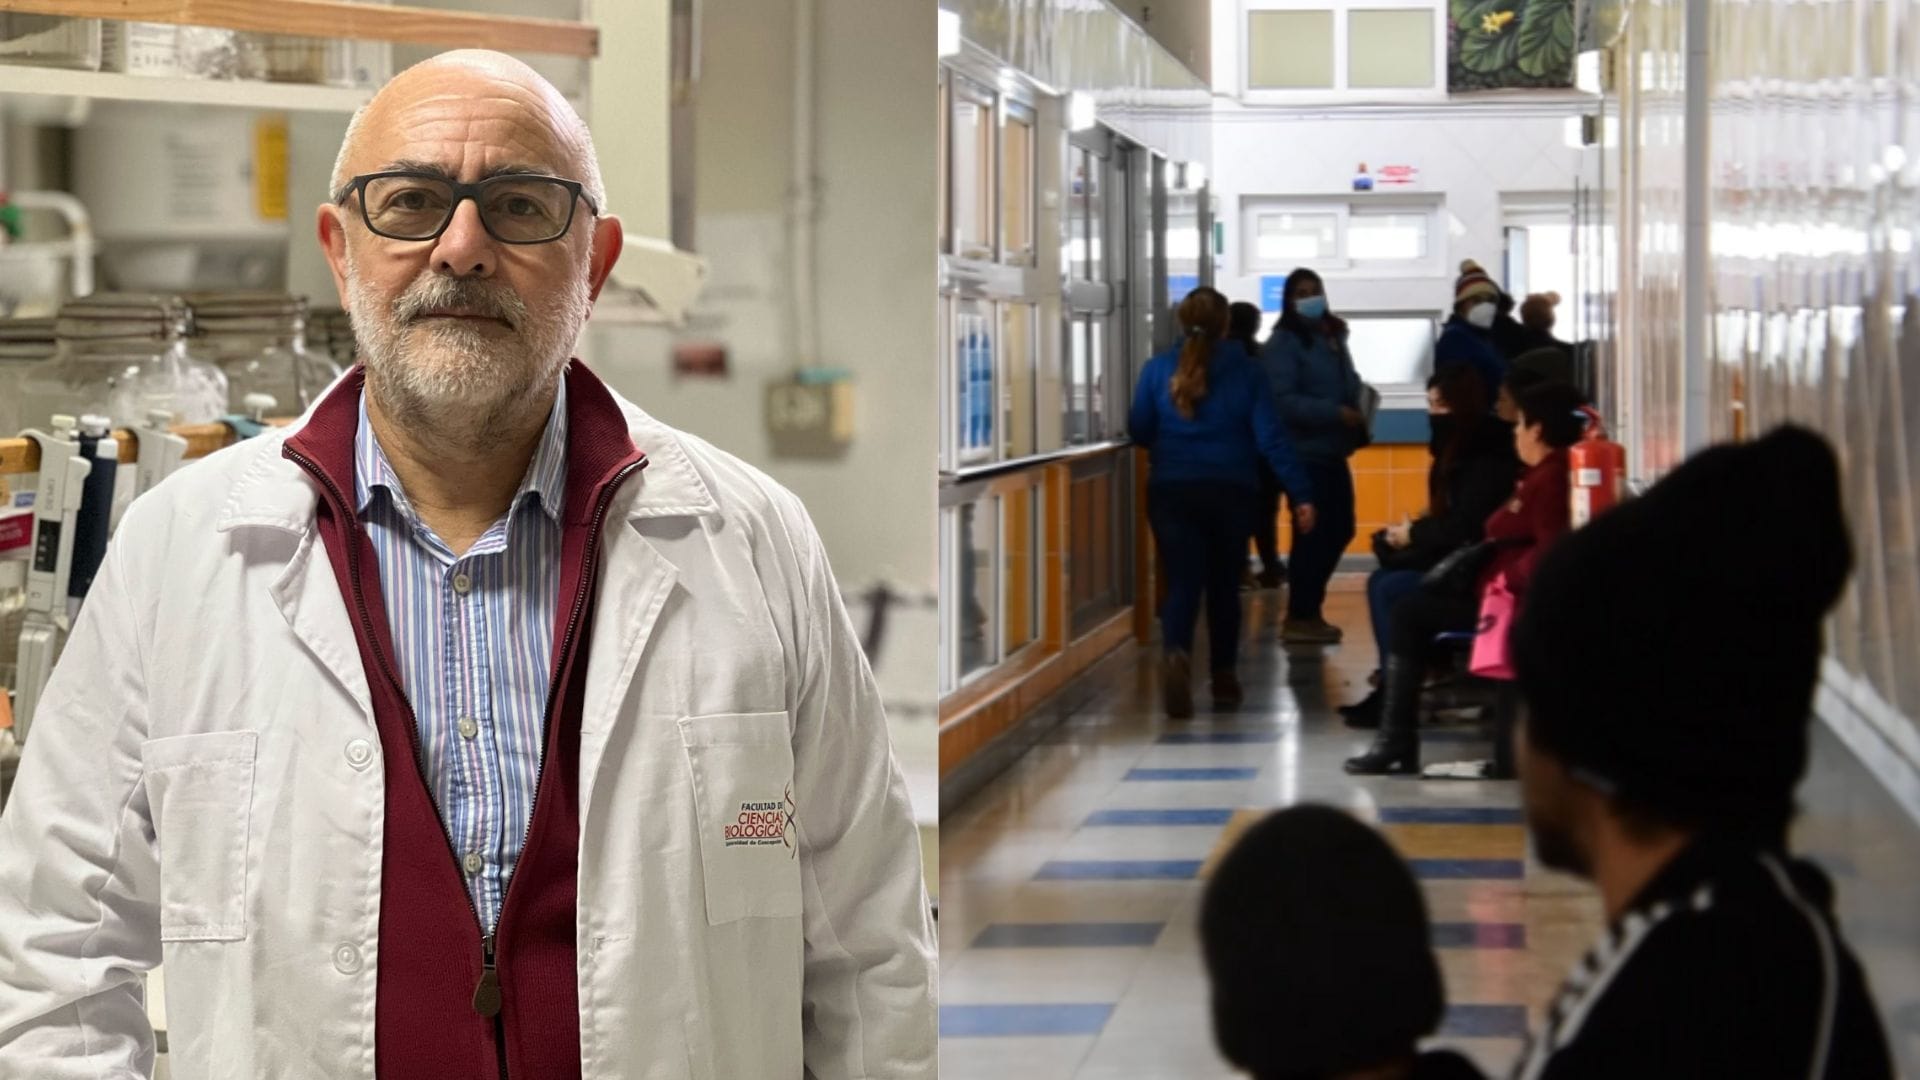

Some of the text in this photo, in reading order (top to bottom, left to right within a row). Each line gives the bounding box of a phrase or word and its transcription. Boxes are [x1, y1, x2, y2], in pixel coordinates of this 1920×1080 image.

[741, 802, 776, 810] FACULTAD
[738, 811, 783, 824] CIENCIAS
[725, 824, 783, 838] BIOLOGICAS
